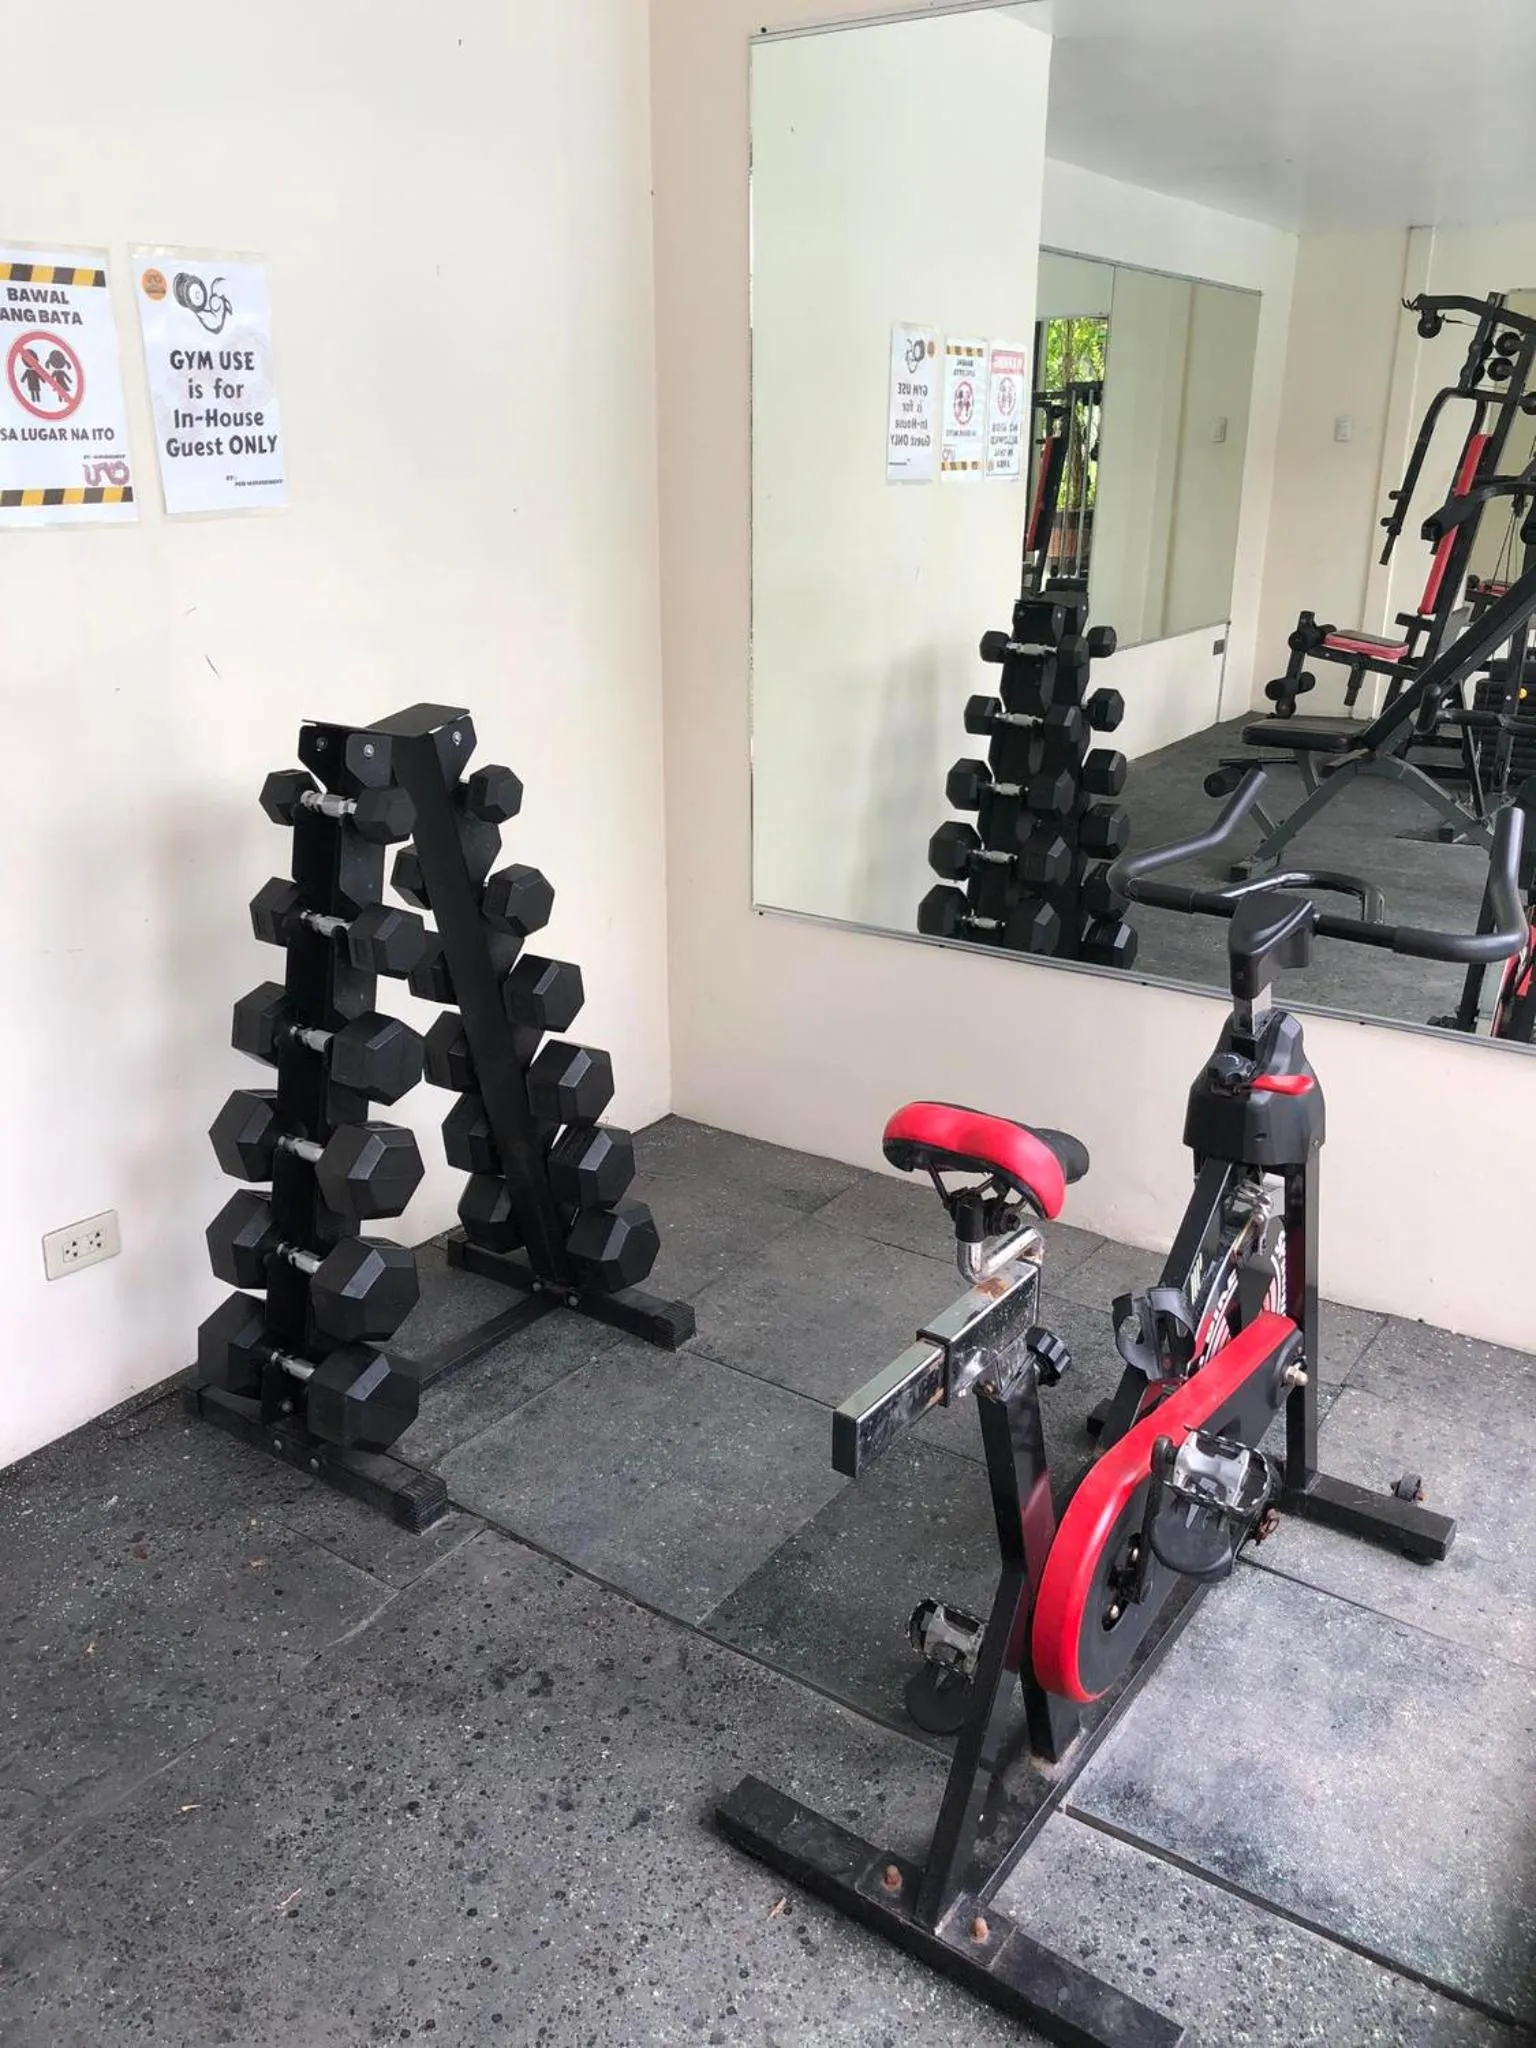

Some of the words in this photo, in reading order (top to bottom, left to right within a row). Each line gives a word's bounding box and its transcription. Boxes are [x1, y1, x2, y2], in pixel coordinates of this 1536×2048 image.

[7, 287, 69, 304] BAWAL
[0, 308, 36, 323] ANG
[39, 310, 83, 325] BATA
[169, 350, 213, 371] GYM
[219, 351, 255, 371] USE
[188, 378, 203, 399] is
[213, 378, 244, 399] for
[174, 408, 264, 429] In-House
[0, 428, 18, 441] SA
[21, 428, 67, 441] LUGAR
[71, 428, 89, 441] NA
[93, 427, 115, 441] ITO
[166, 438, 223, 458] Guest
[229, 435, 278, 455] ONLY
